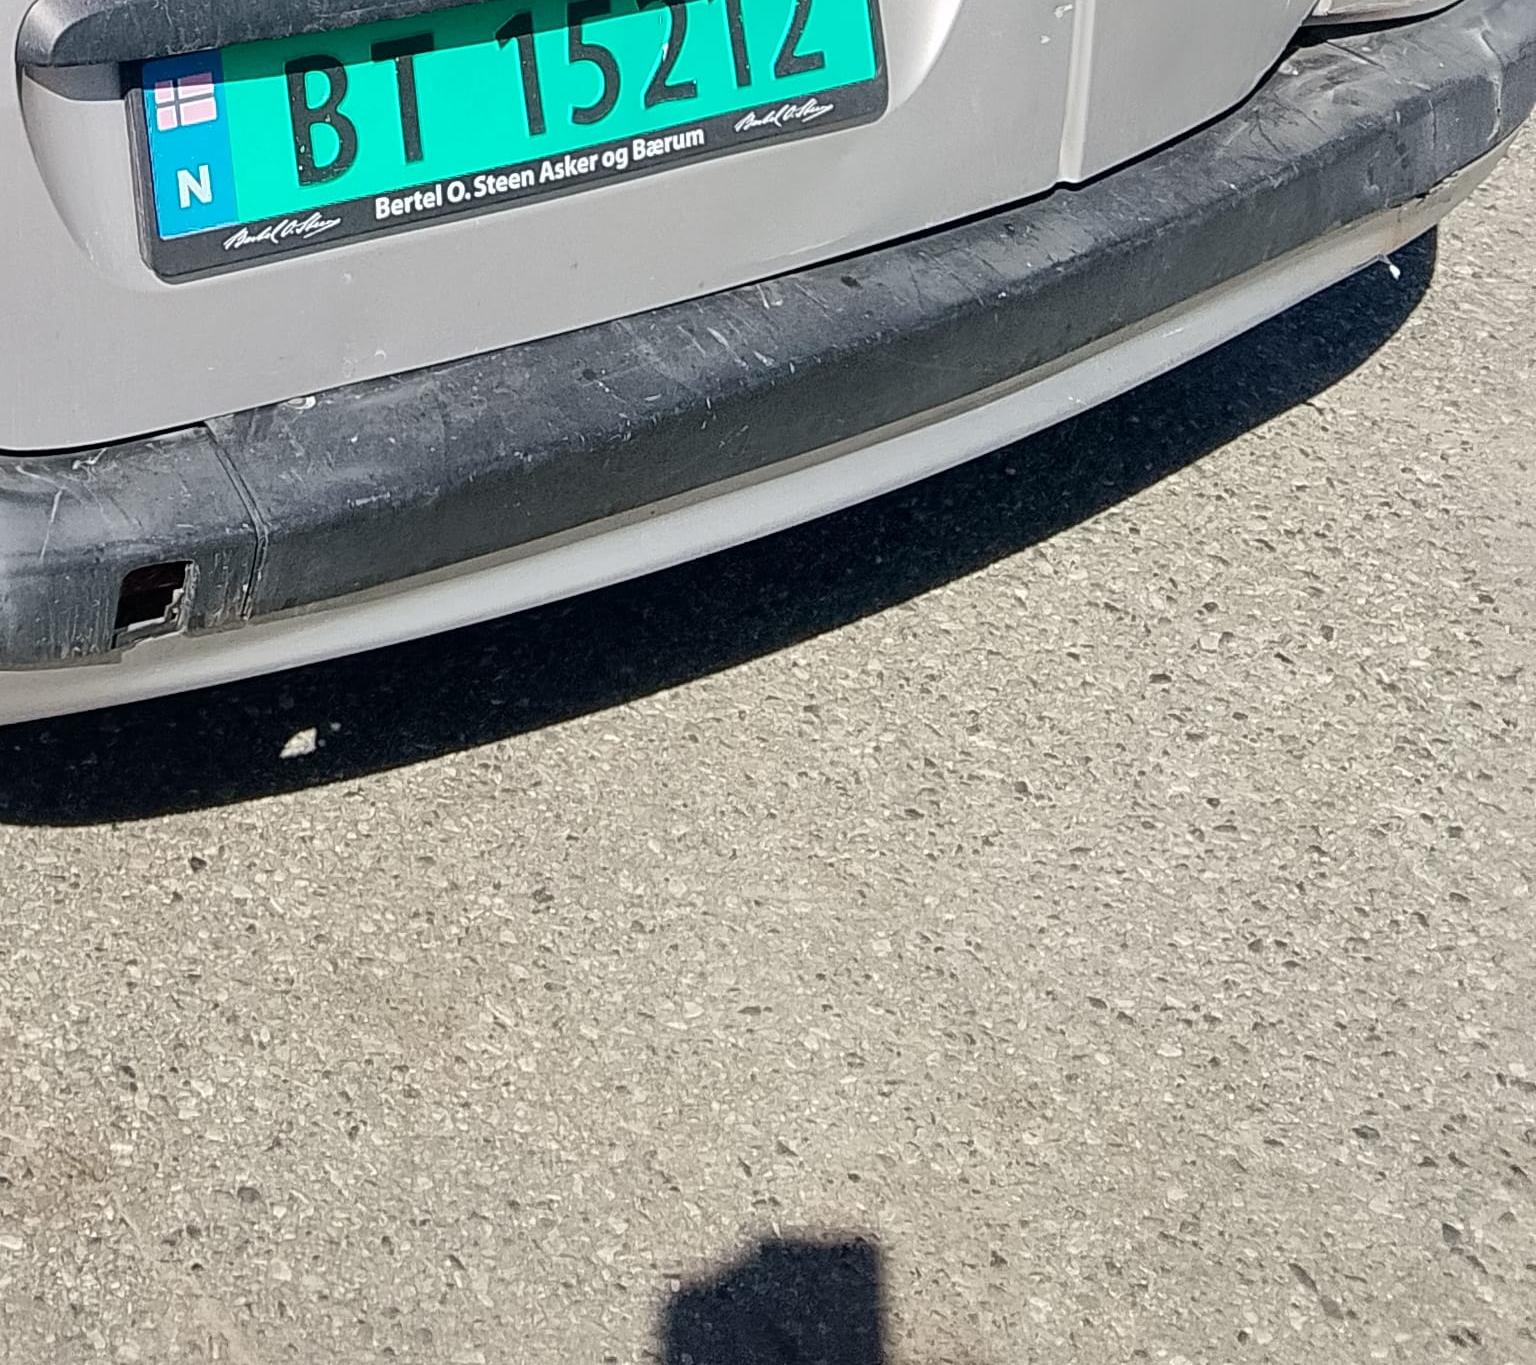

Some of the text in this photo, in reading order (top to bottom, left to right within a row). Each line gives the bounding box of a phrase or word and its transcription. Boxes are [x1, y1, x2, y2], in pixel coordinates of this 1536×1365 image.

[284, 33, 434, 188] BT
[176, 164, 213, 208] N
[375, 128, 705, 219] Bertel O. Steen Asker og Bærum
